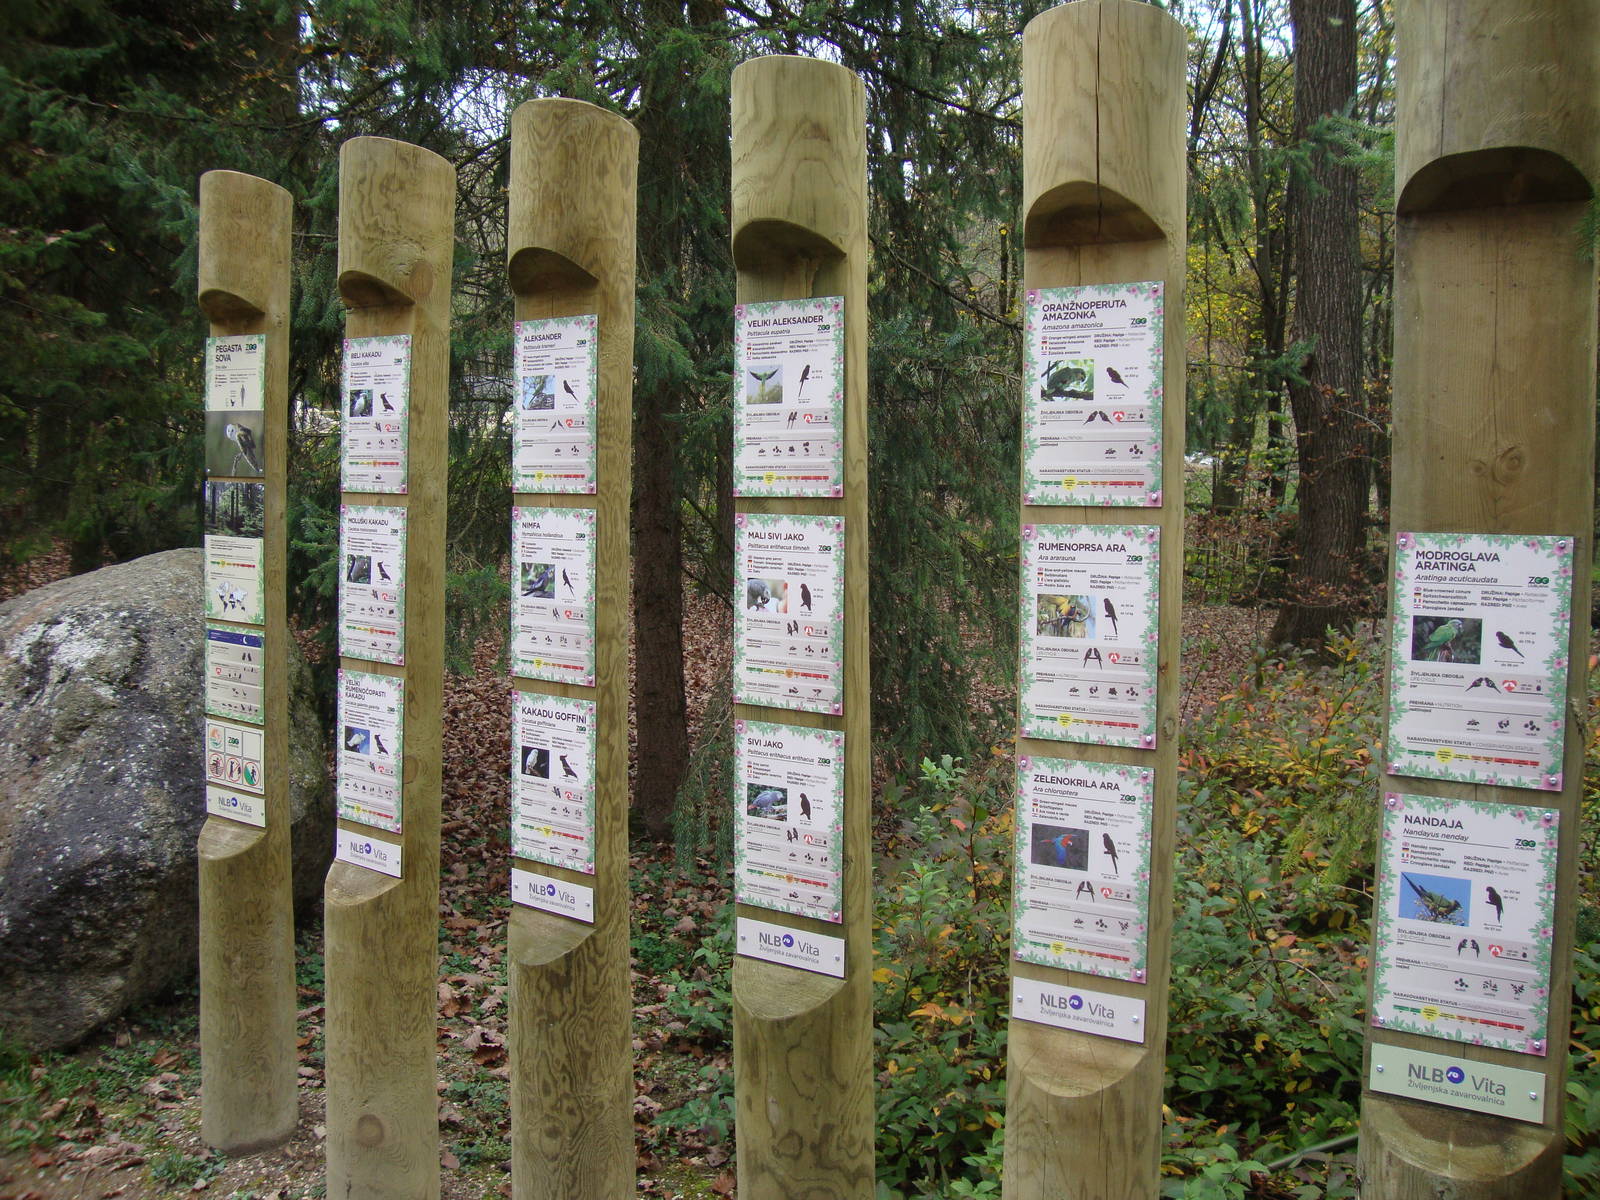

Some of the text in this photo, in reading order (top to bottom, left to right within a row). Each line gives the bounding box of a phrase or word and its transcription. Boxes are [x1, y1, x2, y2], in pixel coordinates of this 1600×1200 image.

[1042, 299, 1127, 312] ORANŽNOPERUTA
[1042, 310, 1096, 321] AMAZONKA
[1130, 317, 1147, 325] ZOO
[747, 315, 824, 328] VELIKI ALEKSANDER
[1042, 322, 1104, 331] Amazona amazonica
[523, 332, 562, 343] ALEKSANDER
[215, 344, 242, 353] PEGASTA
[215, 354, 231, 362] SOVA
[748, 531, 804, 541] MALI SIVI JAKO
[1038, 542, 1127, 552] RUMENOPRSA ARA
[1126, 554, 1143, 562] ZOO
[1415, 550, 1500, 562] MODROGLAVA
[1415, 561, 1476, 572] ARATINGA
[1415, 574, 1498, 584] Aratinga acuticaudata
[1528, 576, 1550, 584] ZOO
[522, 706, 587, 724] KAKADU GOFFINI
[747, 737, 784, 749] SIVI JAKO
[1034, 774, 1120, 791] ZELENOKRILA ARA
[1044, 787, 1079, 796] chloroptera
[1120, 794, 1136, 802] ZOO
[1403, 814, 1464, 829] NANDAJA
[1403, 828, 1470, 842] Nandayus nenday
[1515, 838, 1537, 848] ZOO
[350, 841, 364, 854] NLB
[373, 848, 387, 861] Vita
[528, 882, 575, 904] NLB Vita
[759, 931, 820, 957] NLB Vita
[1040, 993, 1114, 1020] NLB Vita
[1408, 1063, 1506, 1097] NLB Vita
[1407, 1080, 1505, 1107] Življenjska zavarovalnica
